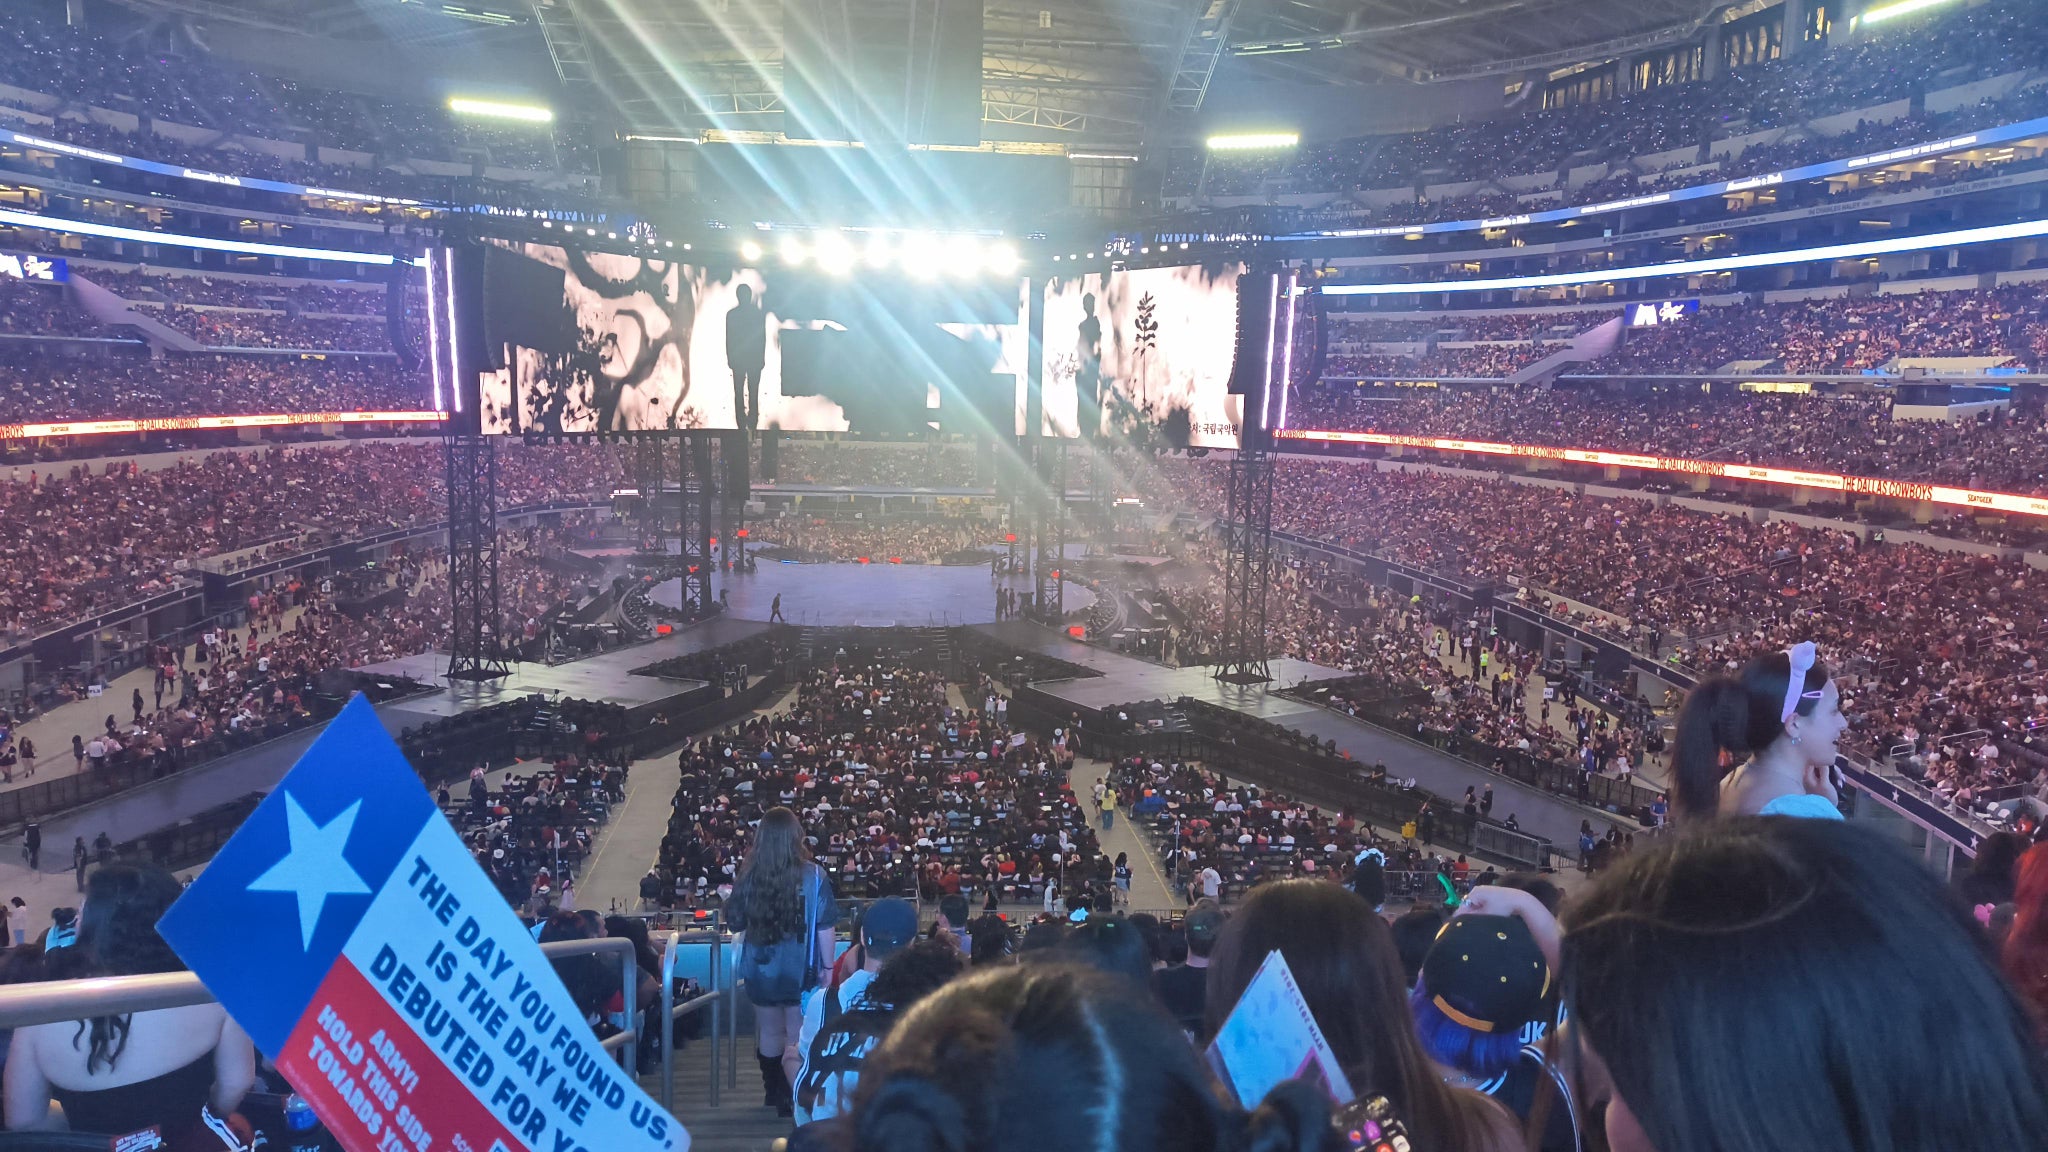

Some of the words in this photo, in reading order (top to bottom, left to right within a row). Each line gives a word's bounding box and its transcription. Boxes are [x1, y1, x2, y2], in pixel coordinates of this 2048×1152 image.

[1203, 423, 1238, 436] 국립국악원
[1657, 457, 1668, 470] THE
[1669, 459, 1692, 473] DALLAS
[1694, 461, 1725, 476] COWBOYS
[1842, 476, 1857, 491] THE
[1858, 478, 1887, 495] DALLAS
[1889, 482, 1933, 500] COWBOYS
[1967, 493, 1993, 504] SEATGEEK
[408, 855, 461, 926] THE
[455, 916, 514, 981] DAY
[509, 972, 556, 1034] YOU
[551, 1024, 625, 1110] FOUND
[630, 1100, 672, 1149] US,
[425, 940, 458, 982] IS
[457, 972, 508, 1039] THE
[503, 1026, 556, 1087] DAY
[552, 1077, 592, 1127] WE
[308, 1035, 382, 1135] TOWARDS
[317, 1004, 365, 1065] HOLD
[362, 1058, 399, 1111] THIS
[395, 1105, 432, 1152] SIDE
[369, 943, 494, 1088] DEBUTED
[491, 1076, 547, 1146] FOR
[369, 1029, 419, 1094] ARMY!
